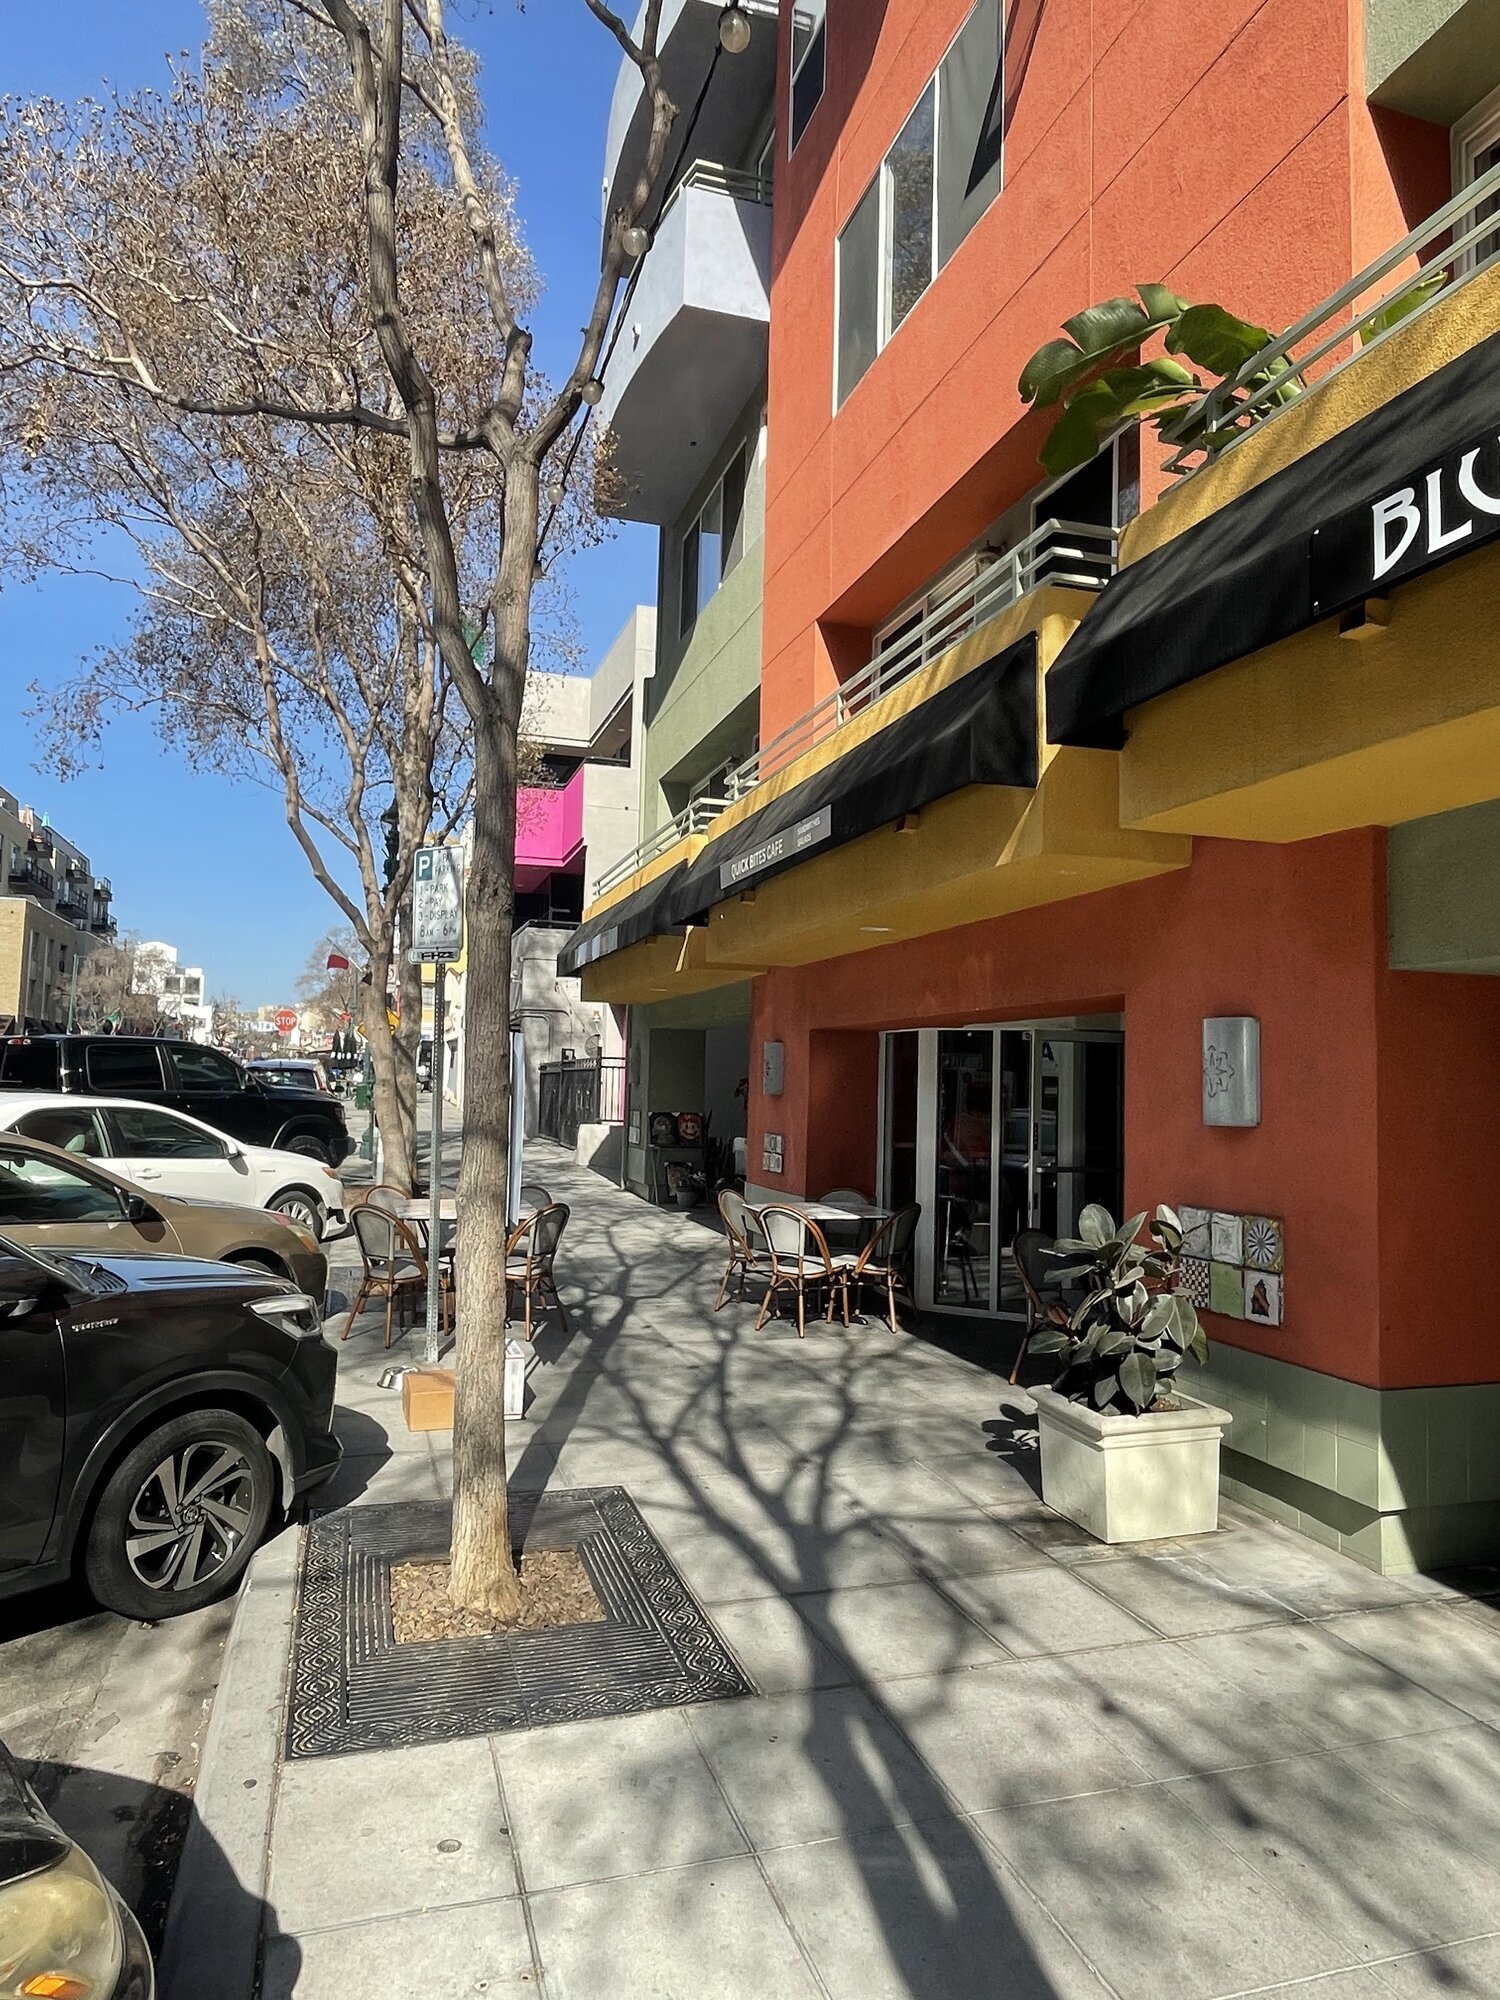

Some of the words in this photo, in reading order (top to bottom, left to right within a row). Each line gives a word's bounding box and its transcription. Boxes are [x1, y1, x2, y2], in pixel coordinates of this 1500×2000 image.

[419, 855, 431, 878] P
[731, 857, 749, 879] QUICK
[749, 848, 766, 868] BITES
[766, 838, 783, 860] CAFE
[435, 863, 461, 876] PARKING
[276, 1016, 296, 1025] STOP
[1041, 1041, 1055, 1061] A
